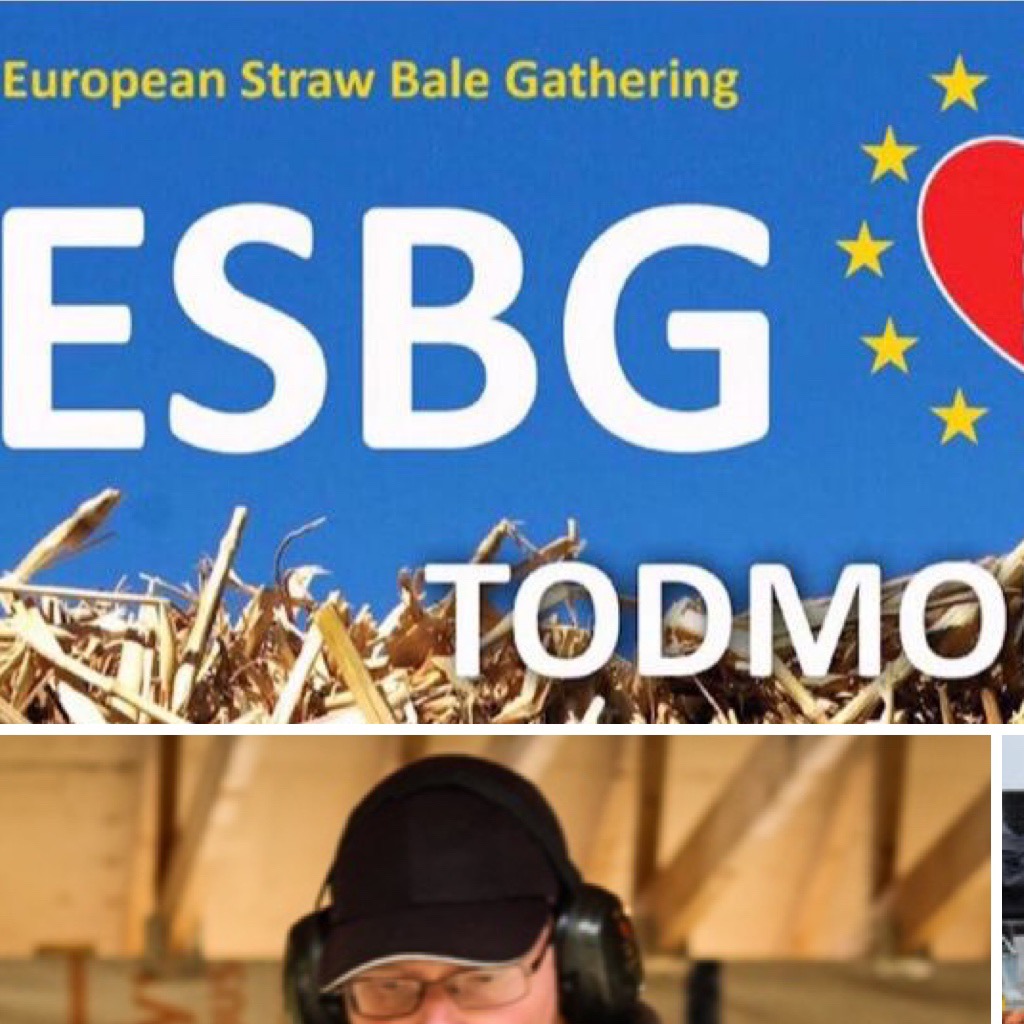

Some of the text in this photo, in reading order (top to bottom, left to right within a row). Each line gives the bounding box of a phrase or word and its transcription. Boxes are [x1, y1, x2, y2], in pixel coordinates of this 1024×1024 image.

[2, 57, 740, 109] European Straw Bale Gathering
[2, 203, 770, 454] ESBG
